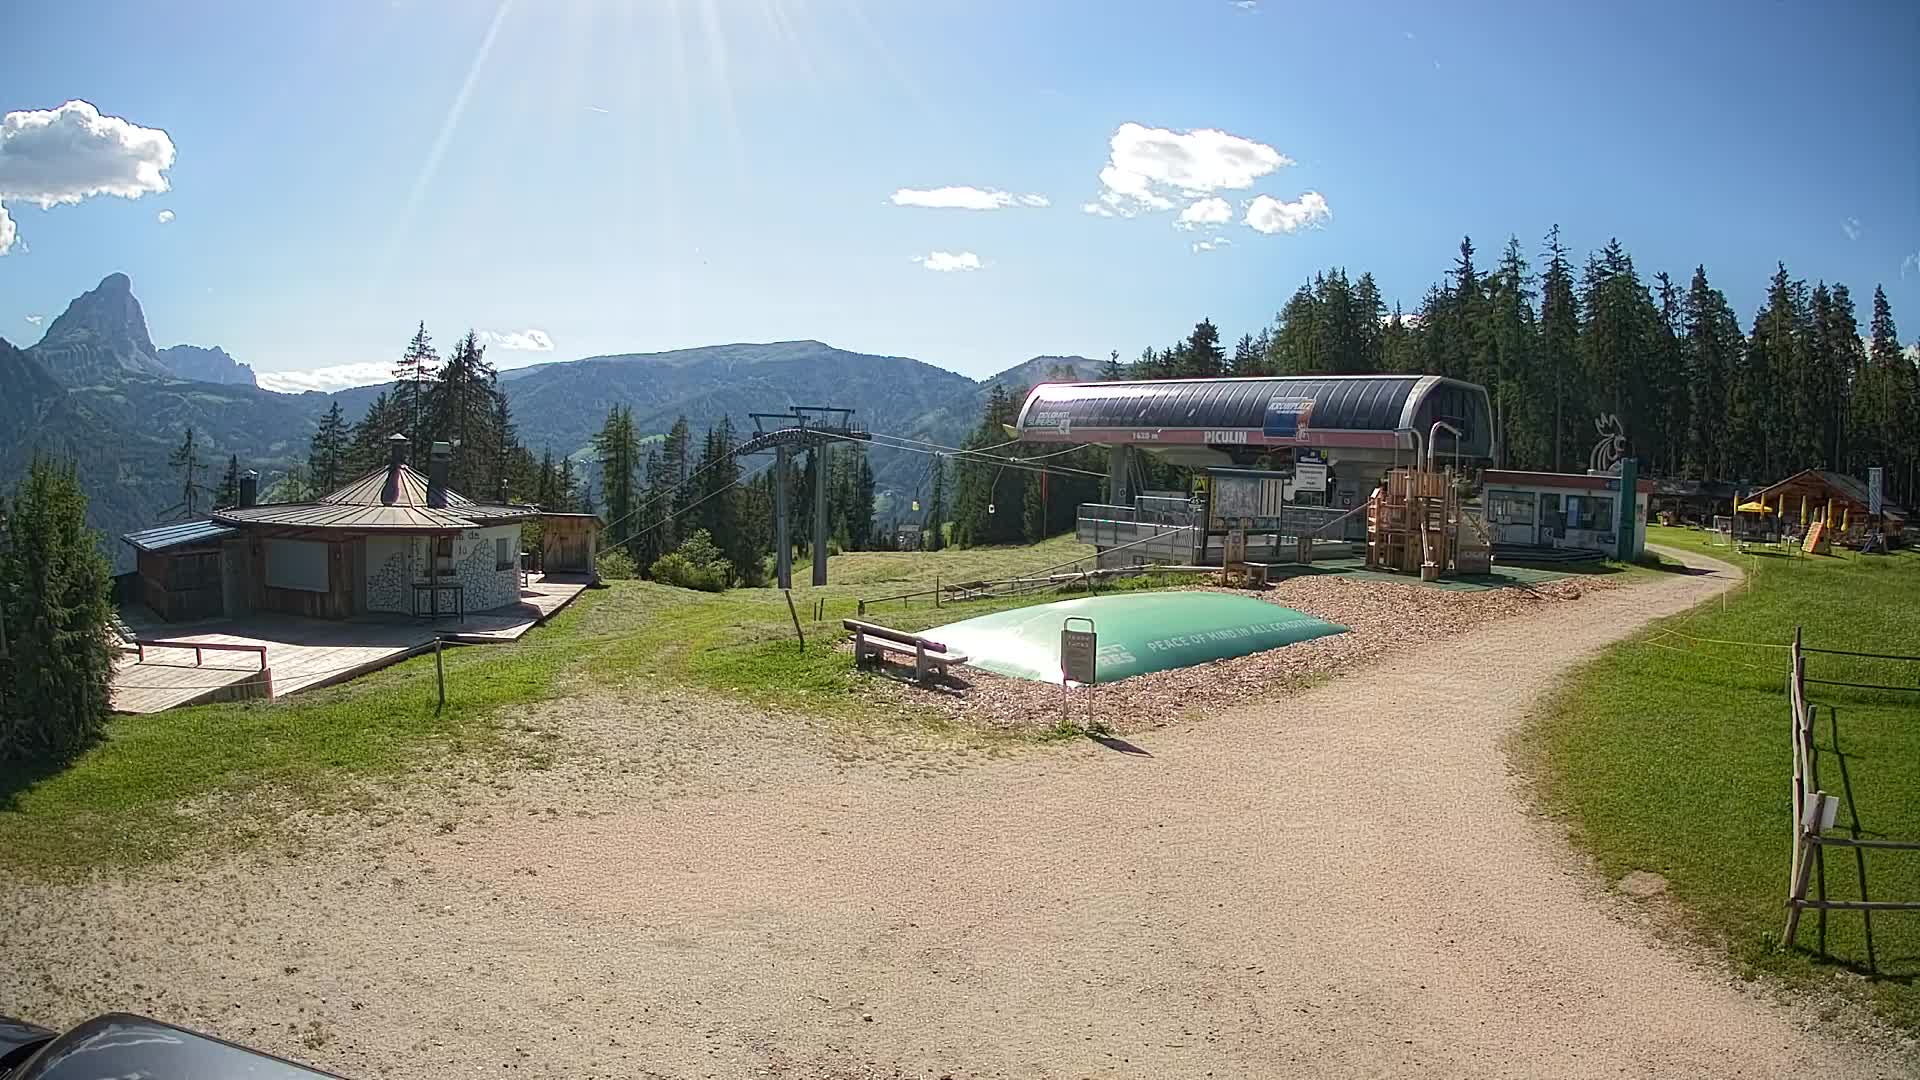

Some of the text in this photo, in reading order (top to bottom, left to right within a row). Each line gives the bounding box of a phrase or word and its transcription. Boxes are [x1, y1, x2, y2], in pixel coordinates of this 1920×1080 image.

[1204, 431, 1248, 444] PICULIN
[1147, 636, 1190, 653] PEACE
[1190, 633, 1207, 645] OF
[1206, 629, 1237, 641] MIND
[1250, 624, 1272, 634] ALL
